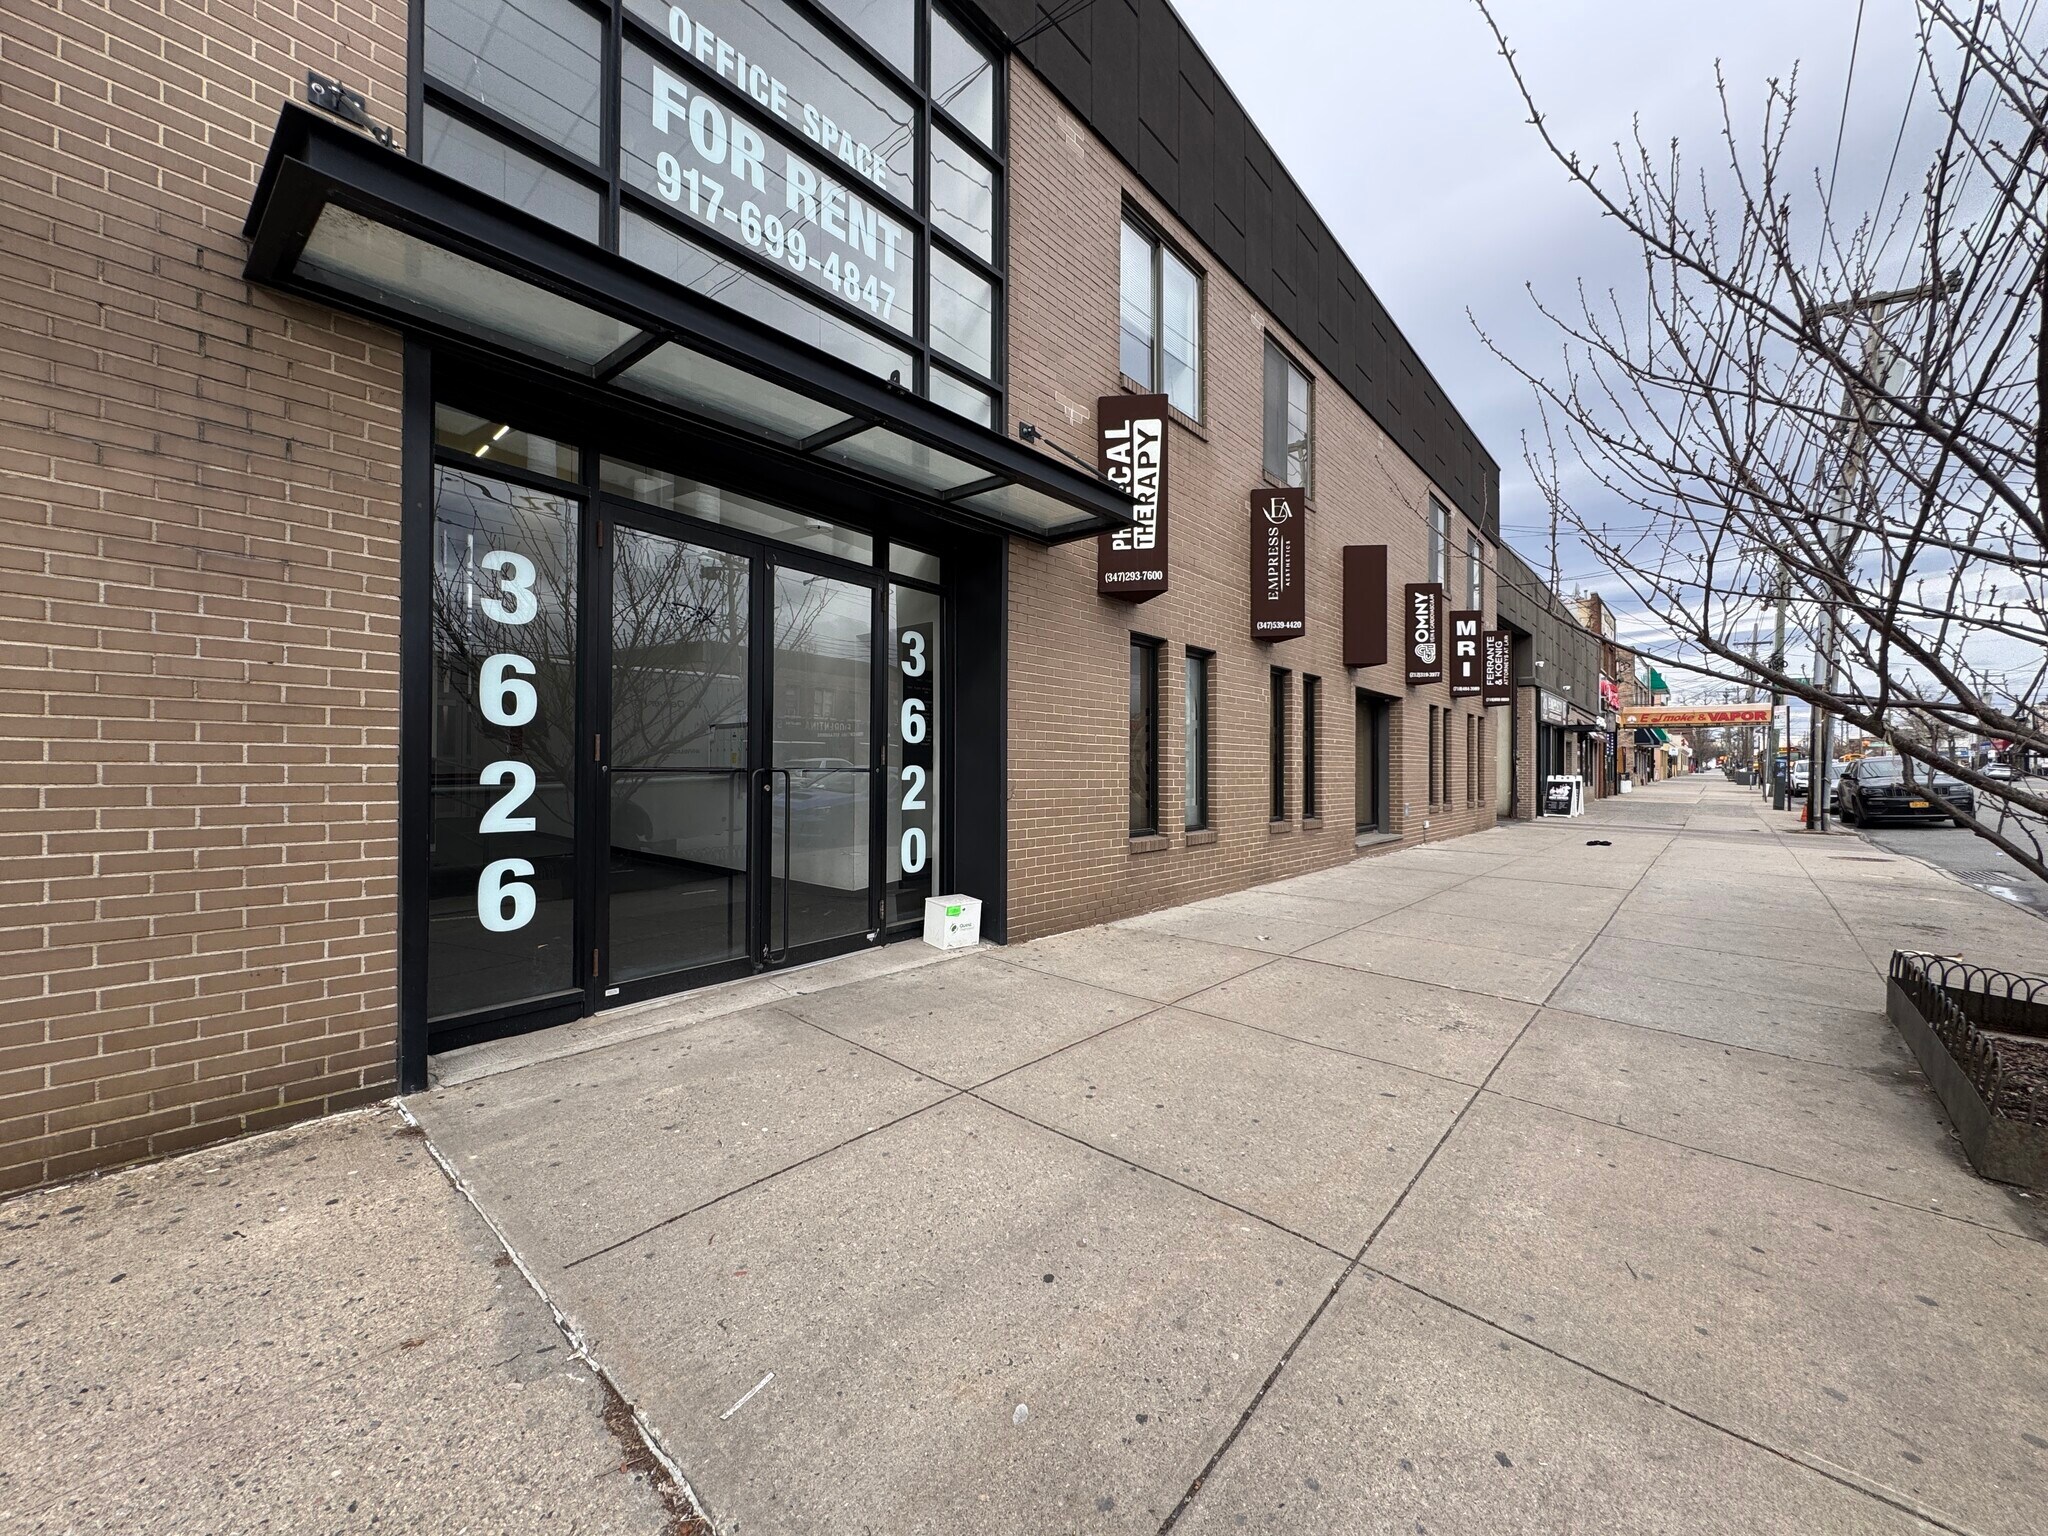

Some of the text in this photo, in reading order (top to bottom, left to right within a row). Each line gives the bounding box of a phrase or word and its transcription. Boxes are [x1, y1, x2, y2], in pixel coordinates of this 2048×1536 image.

[669, 6, 887, 191] OFFICE SPACE
[652, 65, 902, 272] FOR RENT
[656, 151, 896, 320] 917-699-4847
[1105, 419, 1132, 550] PHCAL
[1137, 427, 1158, 547] THERAPY
[1105, 570, 1163, 583] (347)293-7600
[1268, 527, 1279, 600] EMPRESS
[1415, 592, 1429, 642] OMNY
[1456, 620, 1476, 677] MRI
[1486, 636, 1495, 685] FERRANTE
[1495, 641, 1503, 676] KOENIG
[477, 550, 538, 932] 3626
[901, 631, 926, 873] 3620
[1707, 711, 1768, 721] VAPOR
